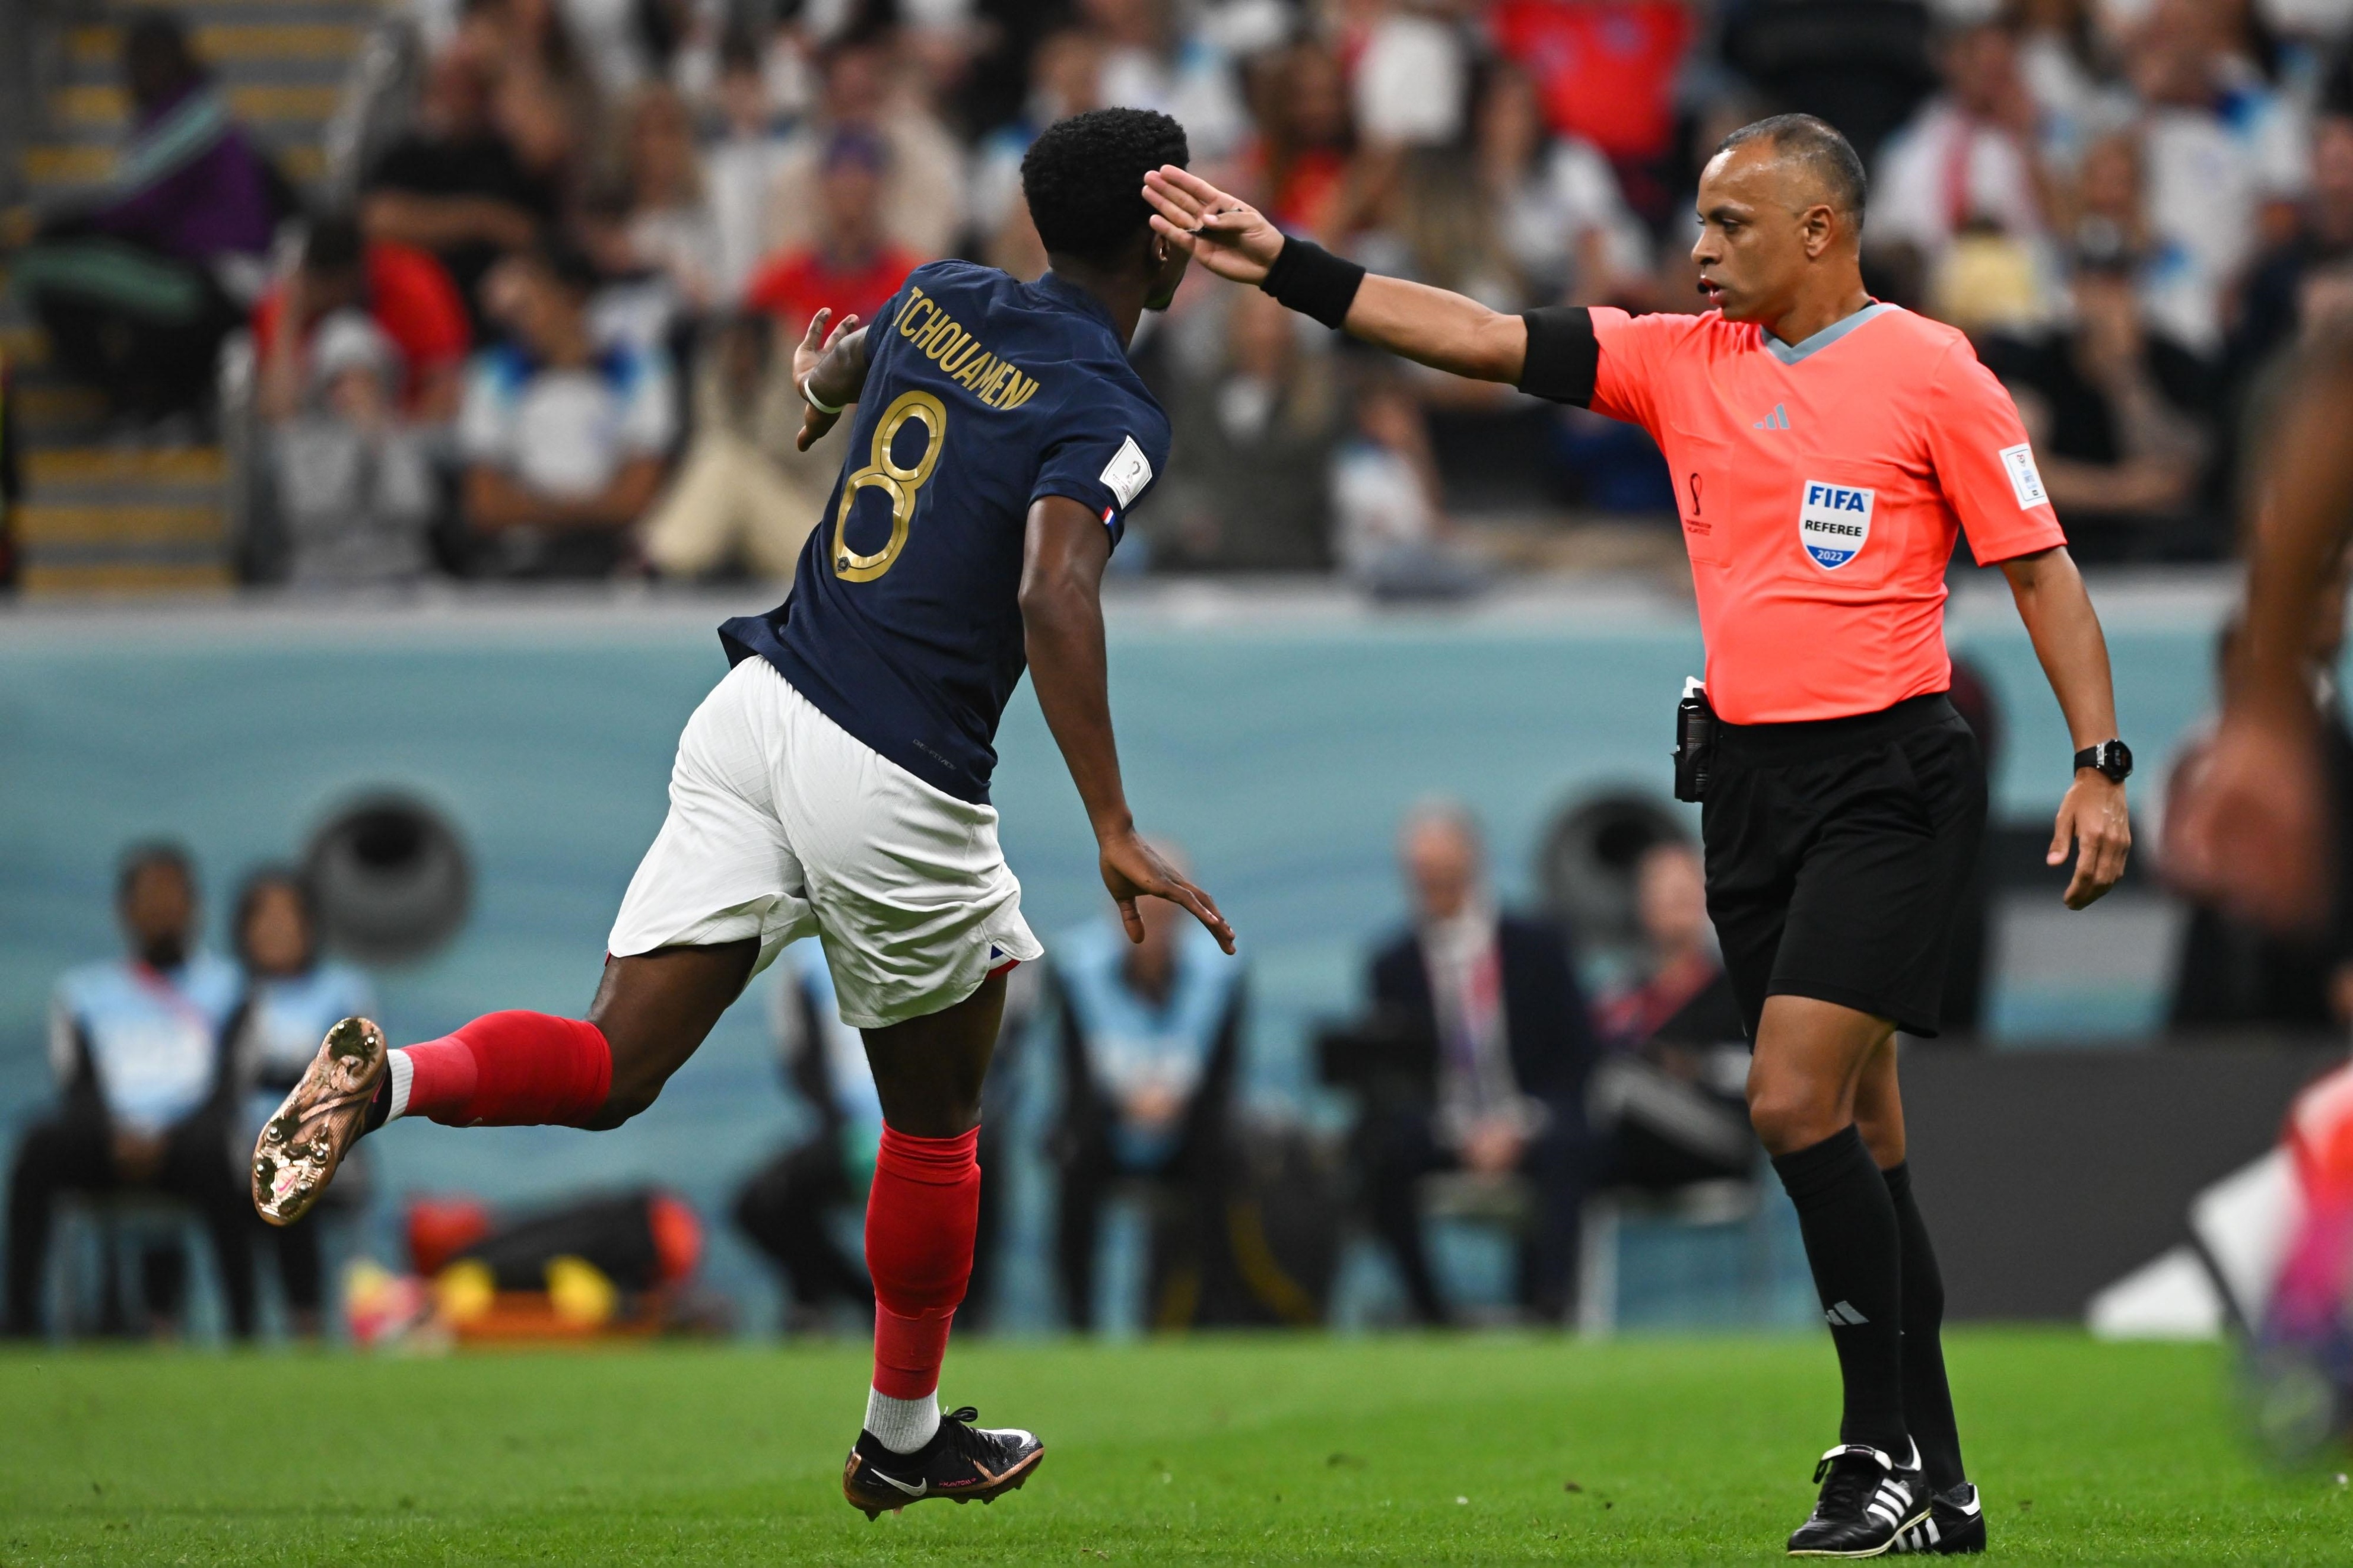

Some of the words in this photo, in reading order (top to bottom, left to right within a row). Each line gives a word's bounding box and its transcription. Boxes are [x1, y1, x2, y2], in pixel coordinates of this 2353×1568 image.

[893, 286, 1040, 411] TCHOUAMENI
[830, 390, 947, 583] 8
[1809, 485, 1865, 513] FIFA
[1805, 519, 1863, 537] REFEREE
[1817, 549, 1844, 562] 2022
